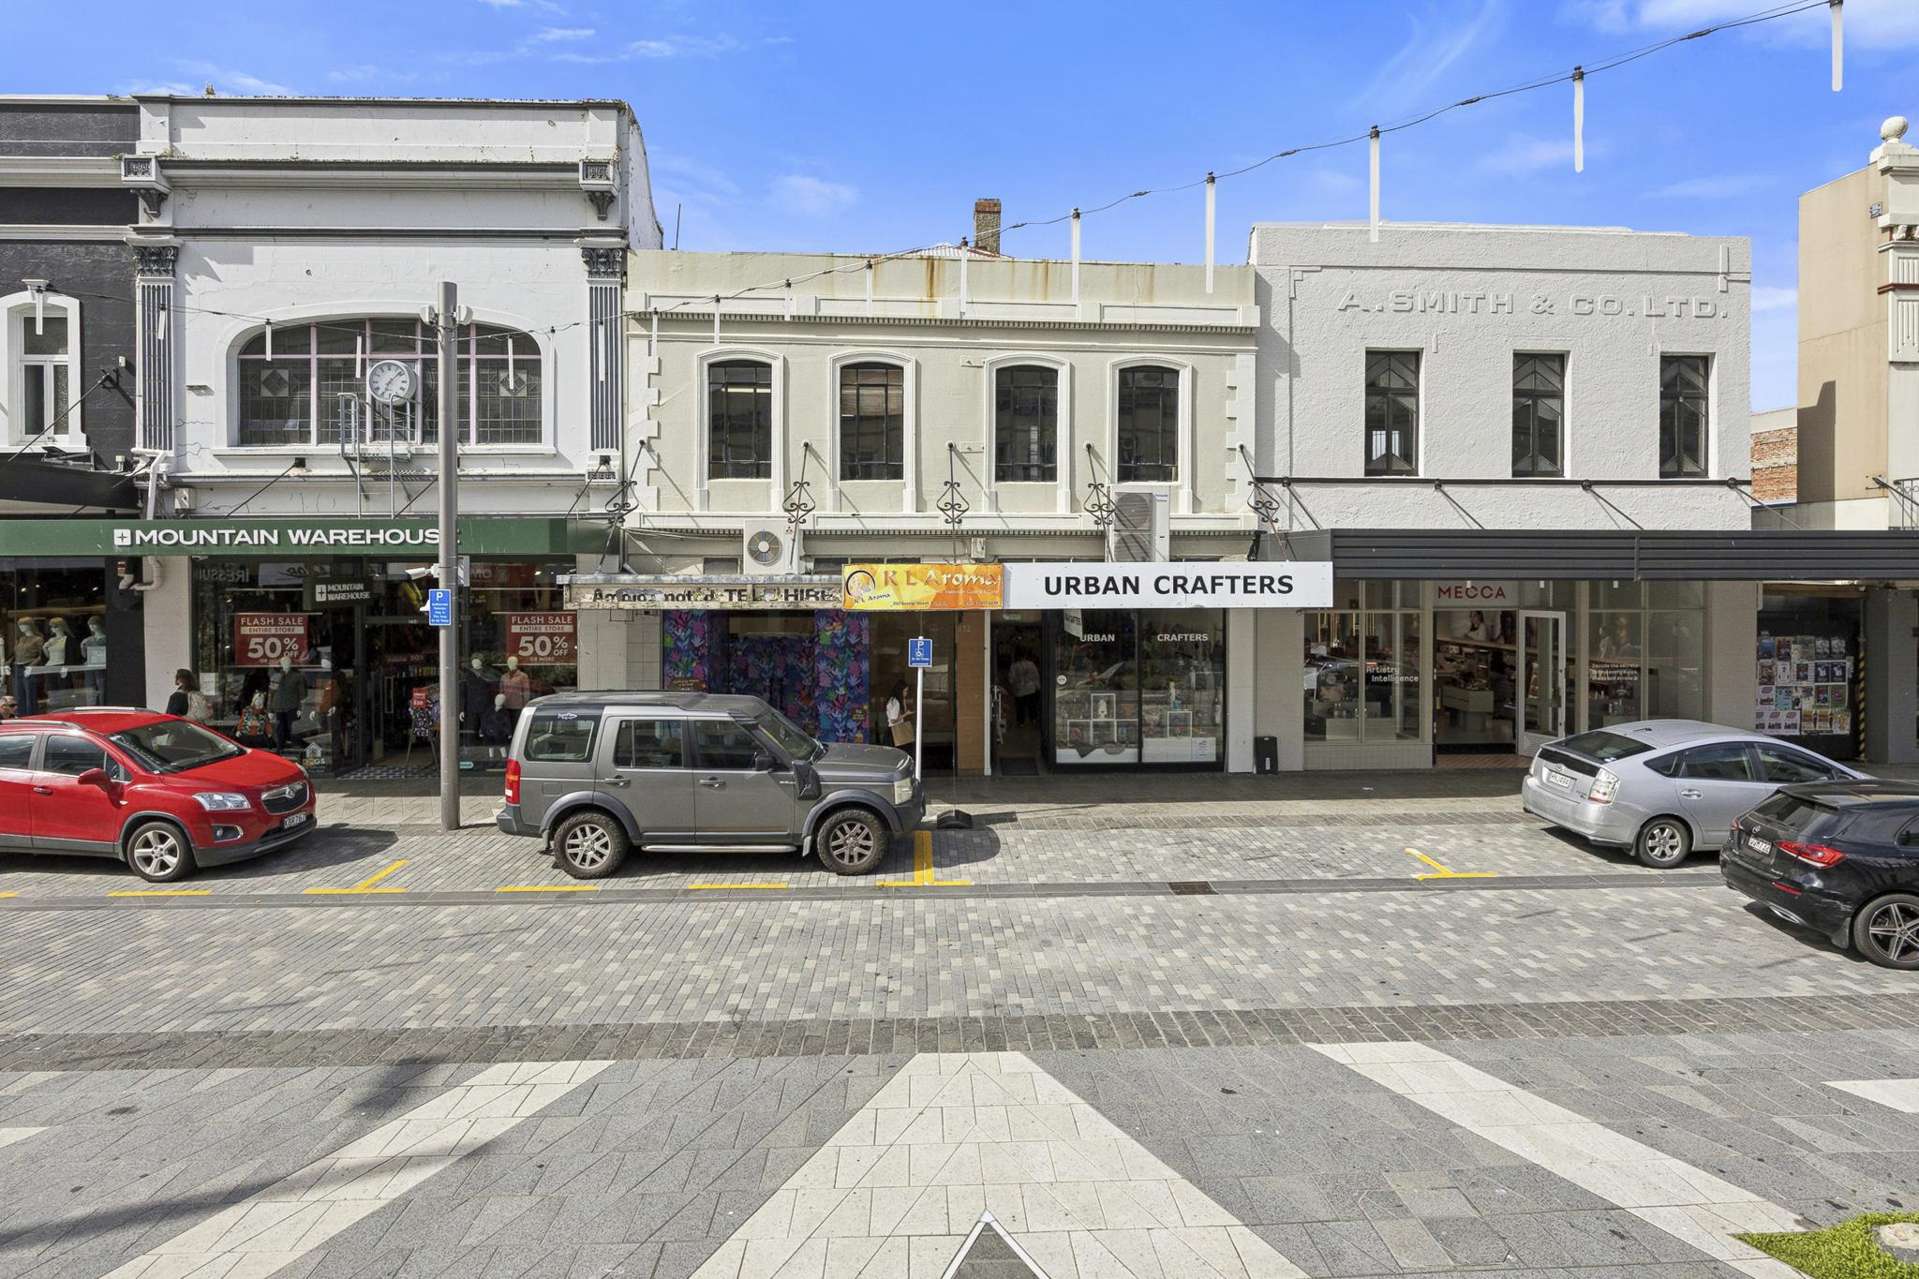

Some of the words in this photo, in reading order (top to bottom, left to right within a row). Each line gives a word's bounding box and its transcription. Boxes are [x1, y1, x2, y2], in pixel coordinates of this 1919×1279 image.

[1530, 294, 1555, 315] &
[135, 528, 279, 546] MOUNTAIN
[287, 528, 461, 545] WAREHOUS
[328, 583, 365, 592] MOUNTAIN
[1044, 576, 1140, 596] URBAN
[1154, 575, 1294, 595] CRAFTERS
[328, 591, 370, 600] WAREHOUSE
[436, 591, 444, 601] P
[1438, 585, 1506, 600] MECCA
[240, 616, 274, 626] FLASH
[279, 616, 304, 626] SALE
[511, 615, 545, 625] FLASH
[548, 615, 573, 624] SALE
[1080, 633, 1115, 642] URBAN
[1157, 633, 1209, 642] CRAFTERS
[283, 650, 299, 658] OFF
[1366, 665, 1400, 676] Artistry
[1371, 674, 1419, 684] Intelligence
